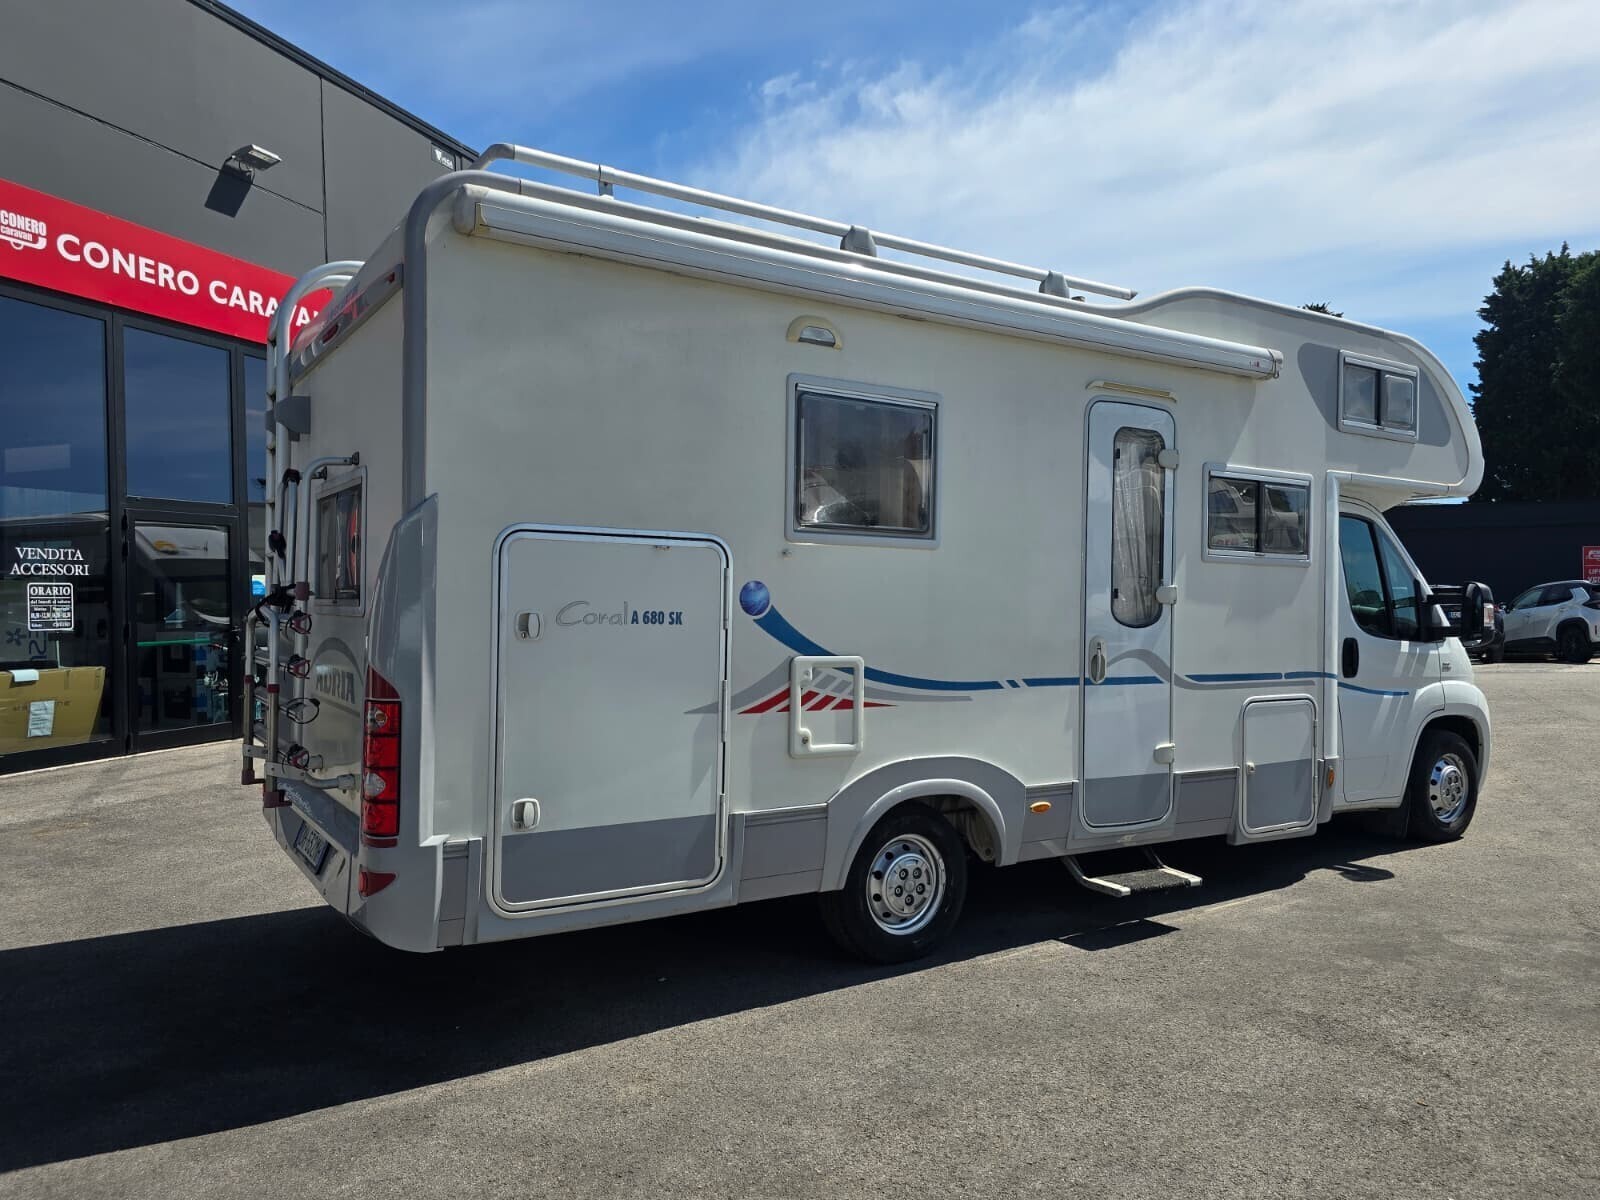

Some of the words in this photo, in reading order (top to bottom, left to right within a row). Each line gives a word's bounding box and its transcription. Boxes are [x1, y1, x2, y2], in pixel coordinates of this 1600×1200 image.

[0, 209, 47, 237] CONERO
[56, 233, 200, 295] CONERO
[15, 546, 84, 561] VENDITA
[9, 563, 90, 576] ACCESSORI
[30, 586, 71, 596] ORARIO
[555, 600, 628, 627] Coral
[631, 610, 640, 625] A
[642, 610, 665, 625] 680
[668, 611, 683, 625] SK
